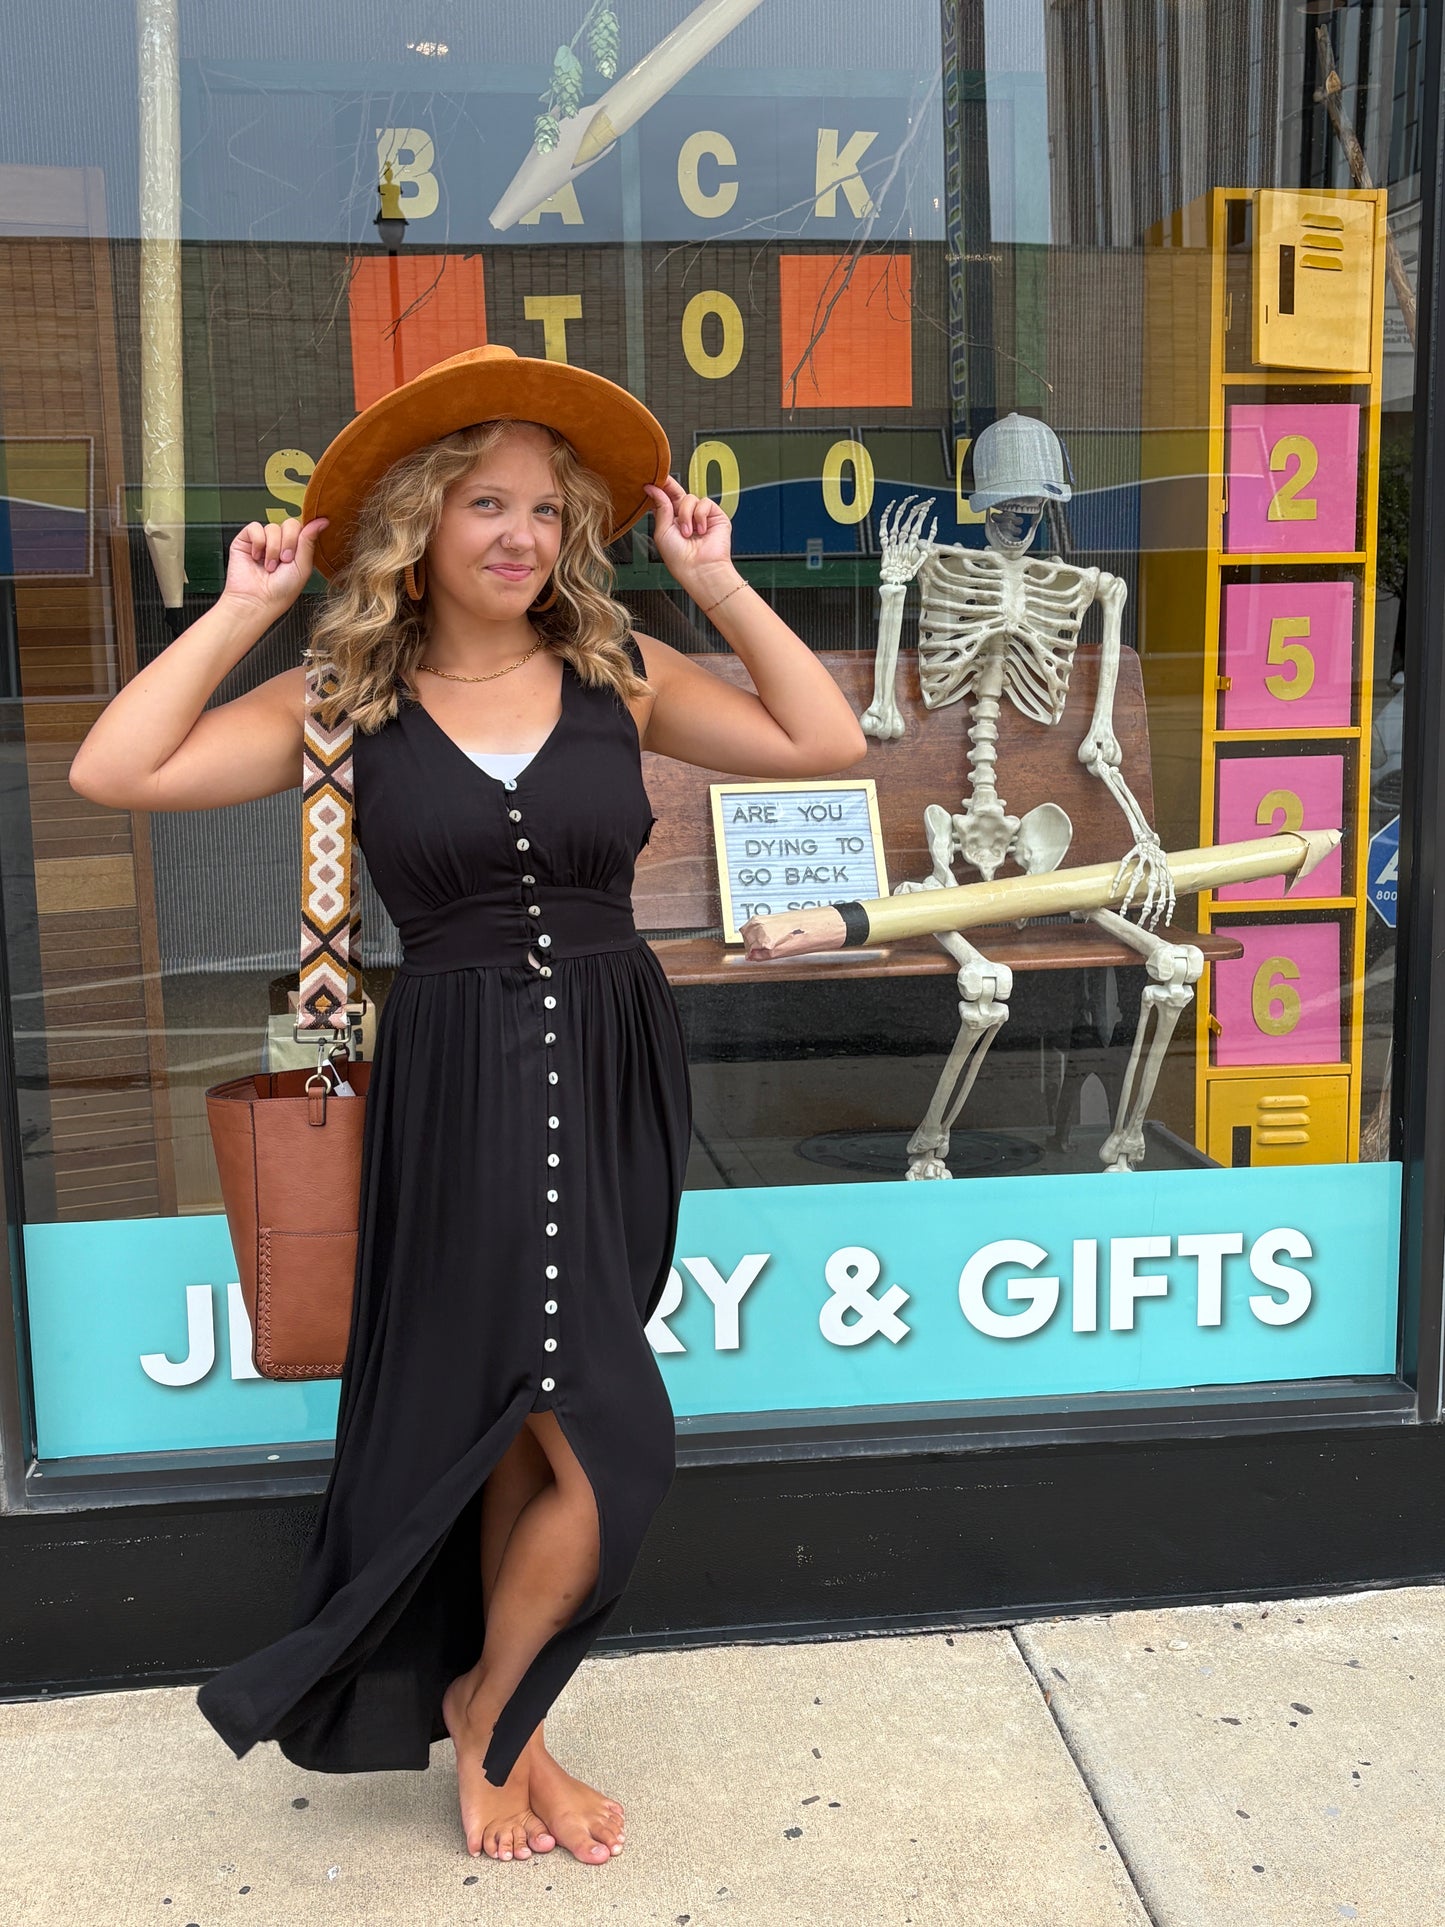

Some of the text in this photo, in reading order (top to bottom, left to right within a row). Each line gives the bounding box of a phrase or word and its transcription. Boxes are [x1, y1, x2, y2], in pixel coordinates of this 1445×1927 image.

[523, 290, 744, 380] TO
[264, 438, 1003, 526] SOOL
[1267, 434, 1319, 521] 2
[1264, 616, 1315, 701] 5
[733, 804, 843, 823] ARE YOU
[745, 837, 864, 857] DYING TO
[738, 866, 849, 886] GO BACK
[740, 903, 771, 919] TO
[1252, 956, 1300, 1036] 6
[818, 1246, 911, 1347] &
[958, 1227, 1313, 1339] GIFTS
